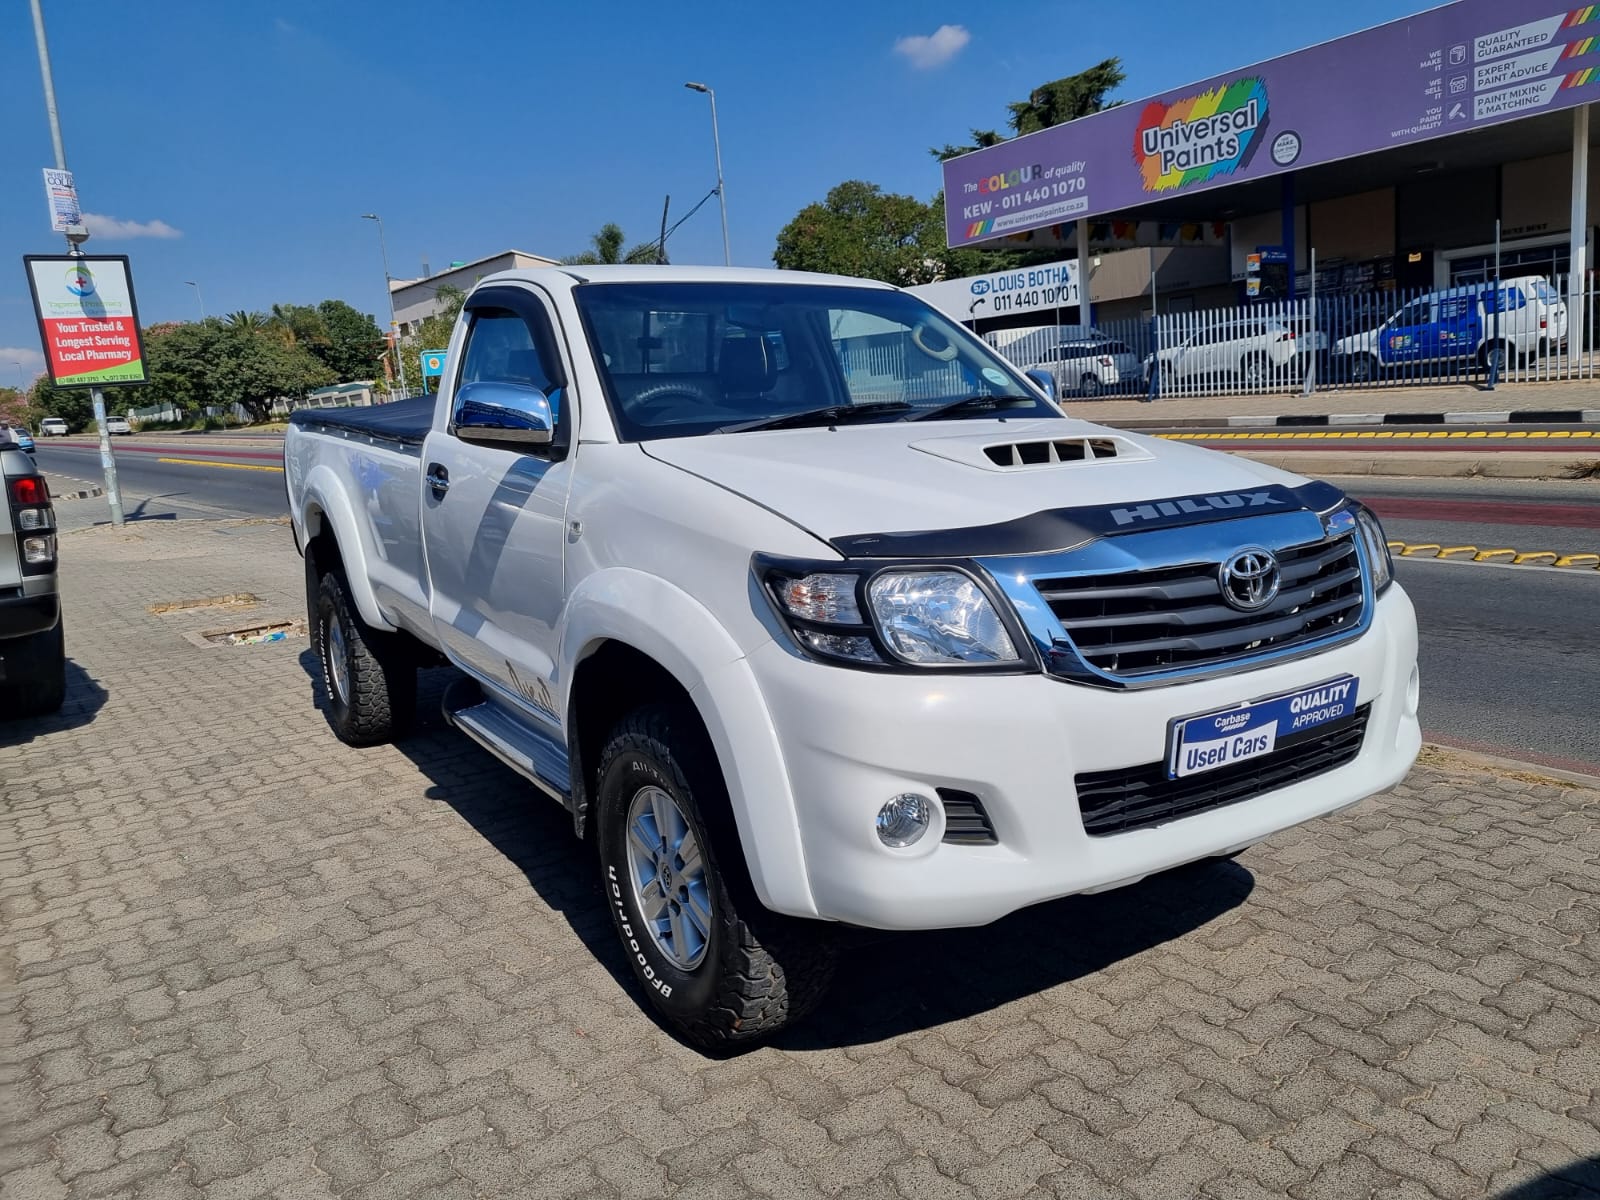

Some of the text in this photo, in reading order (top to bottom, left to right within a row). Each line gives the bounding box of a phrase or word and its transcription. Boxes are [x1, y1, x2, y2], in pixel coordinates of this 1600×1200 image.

[1477, 30, 1521, 49] QUALITY
[1477, 32, 1549, 58] GUARANTEED
[1420, 58, 1442, 68] MAKE
[1429, 50, 1442, 58] WE
[1434, 64, 1442, 72] IT
[1477, 61, 1517, 78] EXPERT
[1477, 62, 1549, 87] PAINT ADVICE
[1424, 86, 1442, 96] SELL
[1429, 79, 1442, 87] WE
[1435, 92, 1442, 100] IT
[1477, 83, 1548, 107] PAINT MIXING
[1477, 95, 1540, 116] & MATCHING
[1420, 114, 1442, 124] PAINT
[1426, 106, 1442, 116] YOU
[1143, 100, 1257, 154] Universal
[1391, 120, 1442, 138] WITH QUALITY
[1161, 135, 1238, 174] Paints
[963, 161, 1086, 195] The COLOUR of quality
[963, 200, 993, 219] KEW
[1002, 193, 1021, 209] 011
[1024, 186, 1050, 203] 440
[1051, 177, 1086, 197] 1070
[996, 201, 1084, 228] www.universalpaints.co.za
[974, 266, 1070, 293] 575 LOUIS BOTHA
[994, 294, 1012, 311] 011
[1015, 290, 1039, 308] 440
[56, 321, 124, 333] Your Trusted &
[55, 335, 131, 349] Longest Serving
[59, 350, 132, 361] Local Pharmacy
[1109, 492, 1286, 526] HILUX
[1290, 682, 1352, 714] QUALITY
[1214, 712, 1251, 728] Carbase
[1292, 703, 1344, 729] APPROVED
[1186, 734, 1268, 770] Used Cars
[608, 865, 674, 999] BFGoodrich
